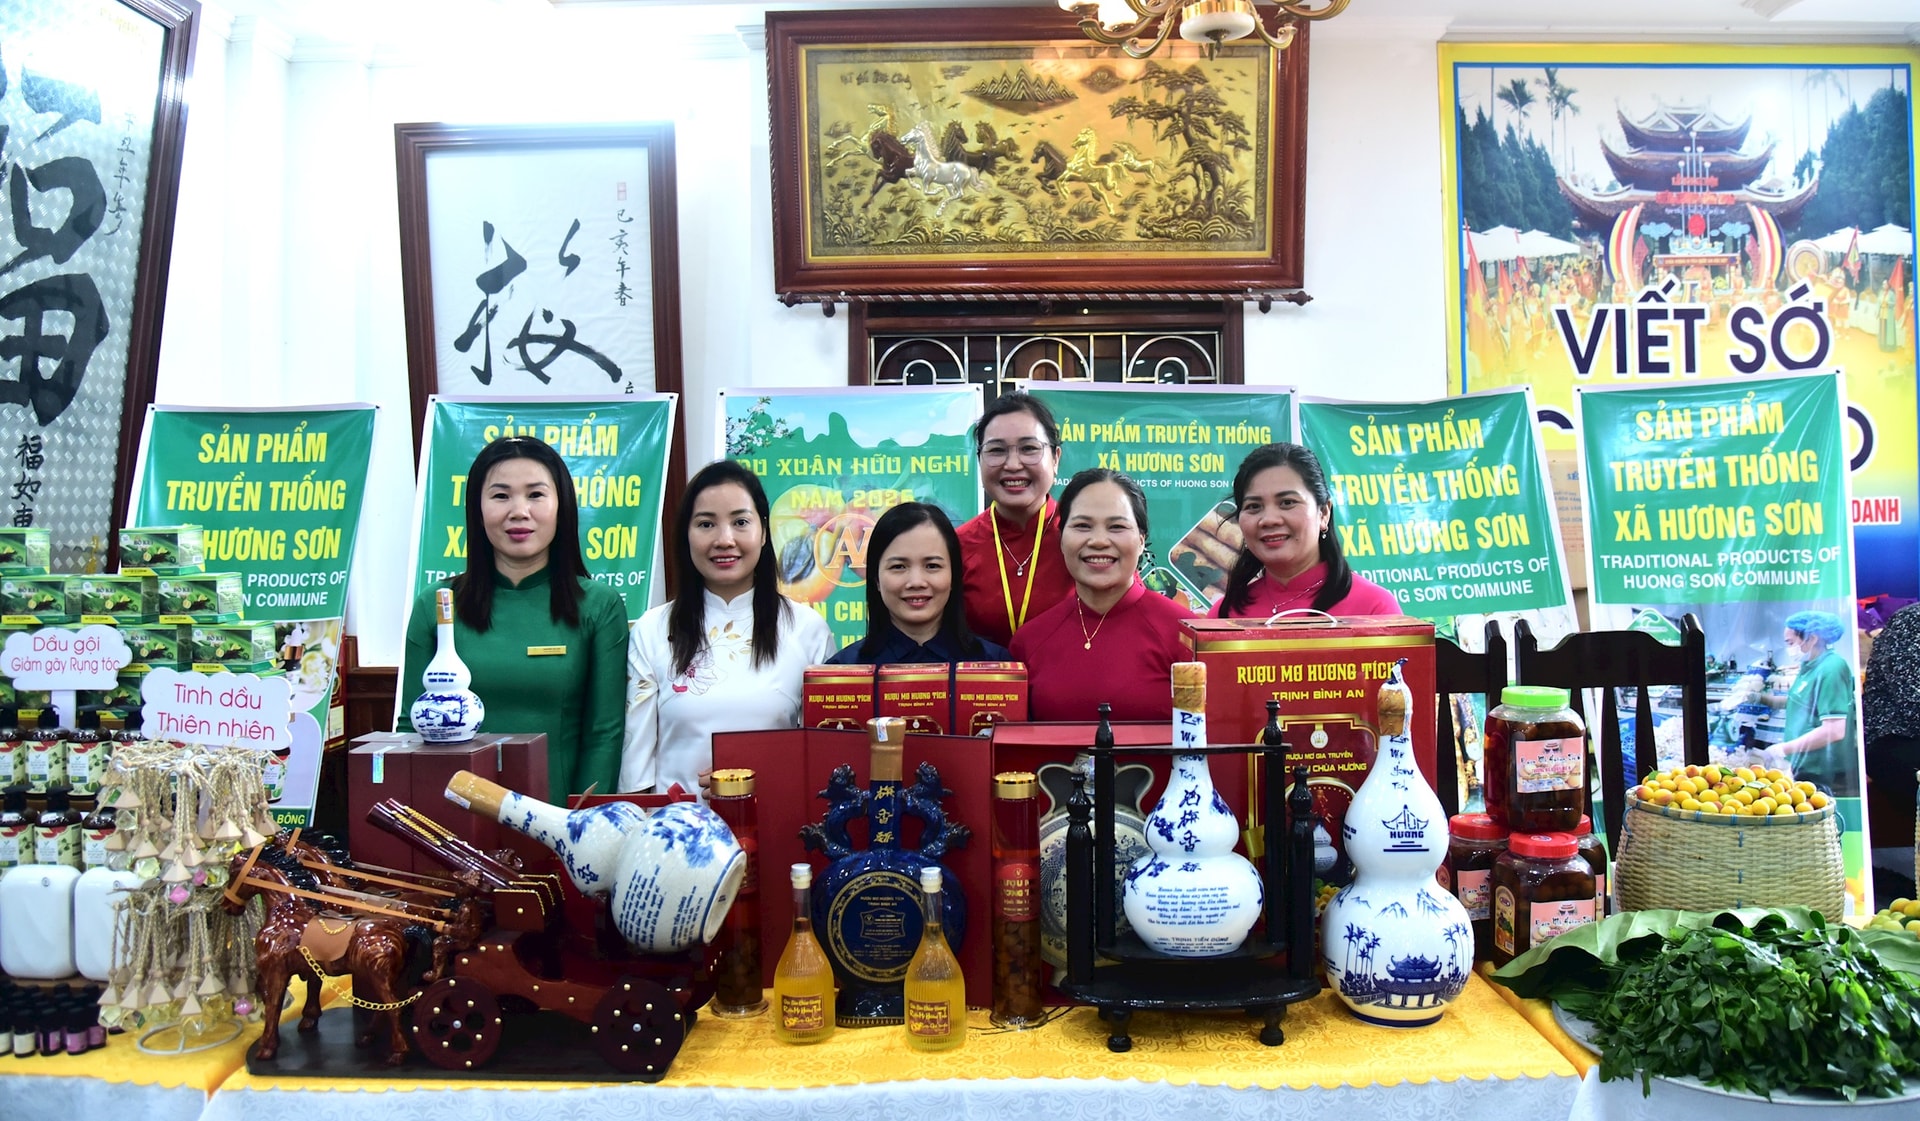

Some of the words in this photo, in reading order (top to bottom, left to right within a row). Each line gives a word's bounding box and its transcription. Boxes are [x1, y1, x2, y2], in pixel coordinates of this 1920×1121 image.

[1555, 279, 1705, 375] VIẾT
[1730, 283, 1832, 374] SỚ
[1635, 400, 1693, 442] SẢN
[1700, 391, 1784, 438] PHẨM
[198, 424, 250, 463] SẢN
[256, 420, 328, 463] PHẨM
[544, 412, 618, 456] PHẨM
[1055, 417, 1085, 442] ẢN
[1090, 417, 1140, 443] PHẨM
[1146, 420, 1210, 444] TRUYỀN
[1216, 420, 1271, 444] THỐNG
[1349, 415, 1402, 457] SẢN
[1408, 408, 1484, 454] PHẨM
[777, 455, 842, 475] XUÂN
[851, 453, 901, 474] HỮU
[911, 455, 969, 477] NGHỊ
[1098, 450, 1121, 471] XÃ
[1126, 452, 1183, 472] HƯƠNG
[1189, 452, 1225, 473] SƠN
[1610, 448, 1717, 492] TRUYỀN
[1723, 441, 1819, 487] THỐNG
[166, 471, 262, 511] TRUYỀN
[269, 470, 347, 511] THỐNG
[576, 465, 641, 508] HỐNG
[1160, 480, 1172, 488] OF
[1175, 480, 1207, 488] HUONG
[1210, 480, 1229, 488] SON
[1331, 462, 1429, 507] TRUYỀN
[1433, 457, 1520, 502] THỐNG
[791, 486, 843, 509] NĂM
[1851, 498, 1899, 523] DANH
[1613, 504, 1652, 542] XÃ
[1659, 503, 1756, 541] HƯƠNG
[1764, 499, 1823, 536] SƠN
[204, 527, 286, 561] HƯƠNG
[293, 525, 341, 560] SƠN
[443, 526, 467, 558] X
[586, 524, 638, 560] SƠN
[1338, 519, 1376, 557] XÃ
[1380, 516, 1469, 556] HƯƠNG
[1475, 512, 1530, 550] SƠN
[1354, 567, 1433, 584] DITIONAL
[1437, 560, 1524, 580] PRODUCTS
[1528, 557, 1549, 573] OF
[1601, 552, 1712, 569] TRADITIONAL
[1717, 548, 1812, 568] PRODUCTS
[1818, 546, 1841, 562] OF
[248, 573, 326, 587] PRODUCTS
[330, 571, 346, 585] OF
[628, 571, 647, 585] OF
[1414, 587, 1448, 602] SON
[1452, 579, 1534, 600] COMMUNE
[1623, 574, 1684, 589] HUONG
[1689, 573, 1726, 588] SON
[1732, 569, 1820, 586] COMMUNE
[256, 592, 328, 607] COMMUNE
[834, 601, 868, 622] CH
[33, 635, 68, 652] Dầu
[73, 636, 100, 655] gội
[11, 656, 42, 672] Giảm
[70, 657, 98, 675] Rụng
[101, 657, 120, 671] tóc
[1237, 666, 1276, 685] RƯỢU
[1281, 664, 1303, 682] MƠ
[1308, 663, 1357, 682] HƯƠNG
[175, 683, 212, 706] Tinh
[220, 686, 262, 710] dầu
[1272, 691, 1309, 702] TRỊNH
[1313, 688, 1342, 700] BÌNH
[1346, 689, 1365, 699] AN
[158, 712, 211, 736] Thiên
[218, 718, 275, 742] nhiên
[1312, 763, 1335, 772] CHÙA
[1338, 762, 1367, 771] HƯƠNG
